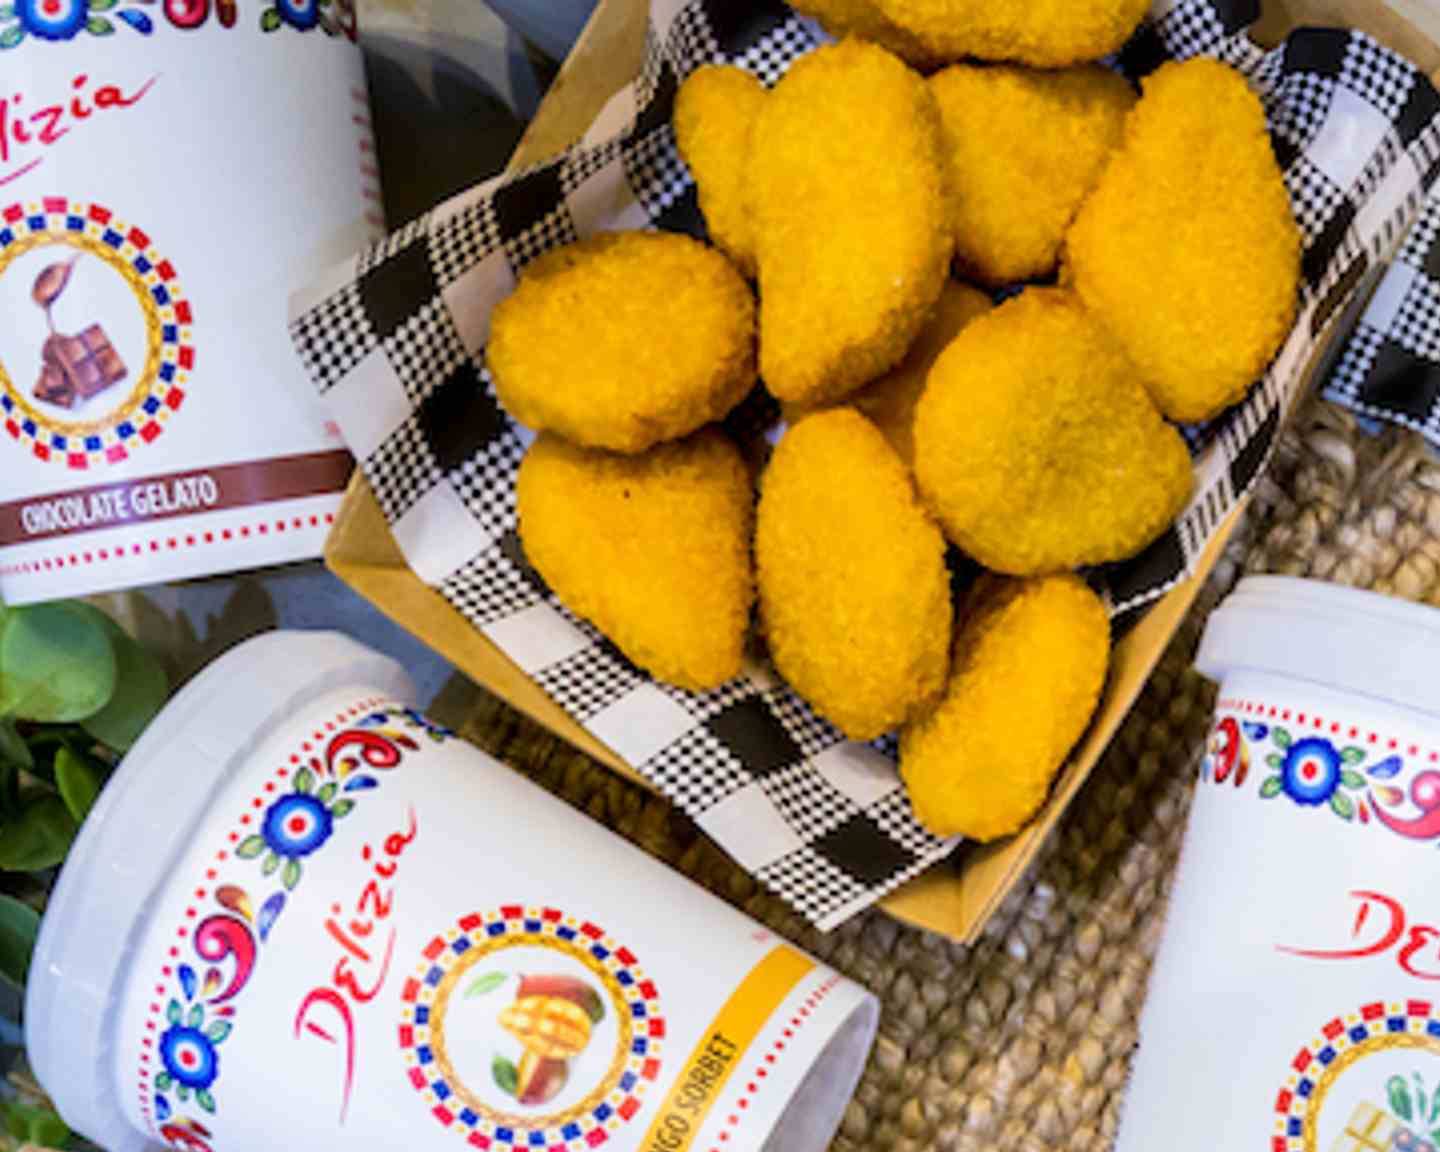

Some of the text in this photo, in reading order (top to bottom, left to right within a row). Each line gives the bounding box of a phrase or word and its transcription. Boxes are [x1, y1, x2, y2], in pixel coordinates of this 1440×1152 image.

[0, 71, 163, 186] lizia
[130, 475, 218, 516] GELATO
[294, 803, 417, 1127] Delizia
[674, 1031, 738, 1116] SORBET
